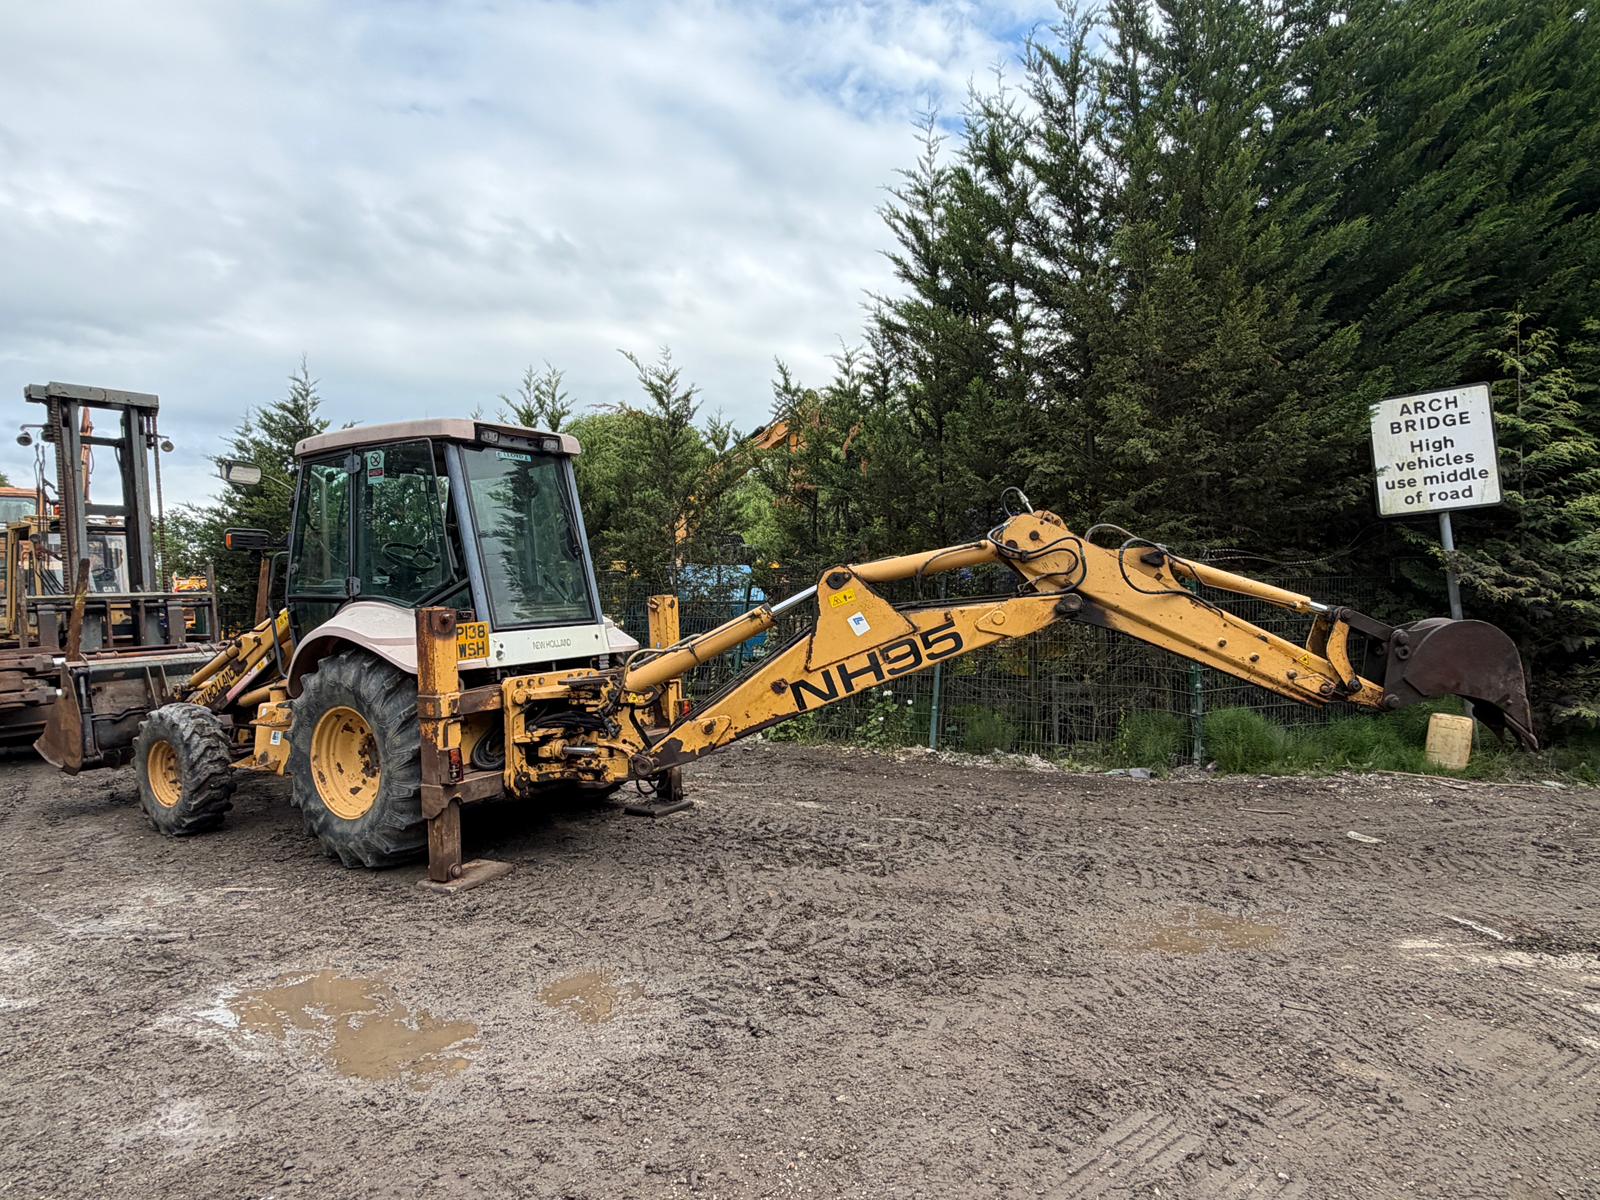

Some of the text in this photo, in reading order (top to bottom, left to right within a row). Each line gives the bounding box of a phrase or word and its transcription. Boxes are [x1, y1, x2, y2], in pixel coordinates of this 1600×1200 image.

[1400, 395, 1458, 416] ARCH
[1390, 411, 1471, 434] BRIDGE
[1410, 436, 1454, 453] High
[1395, 452, 1475, 472] vehicles
[1385, 467, 1489, 490] use middle
[1404, 485, 1473, 505] of road
[456, 625, 485, 641] P138
[459, 641, 485, 658] WSH
[533, 638, 571, 650] NEW HOLLAND
[789, 621, 963, 712] NH95
